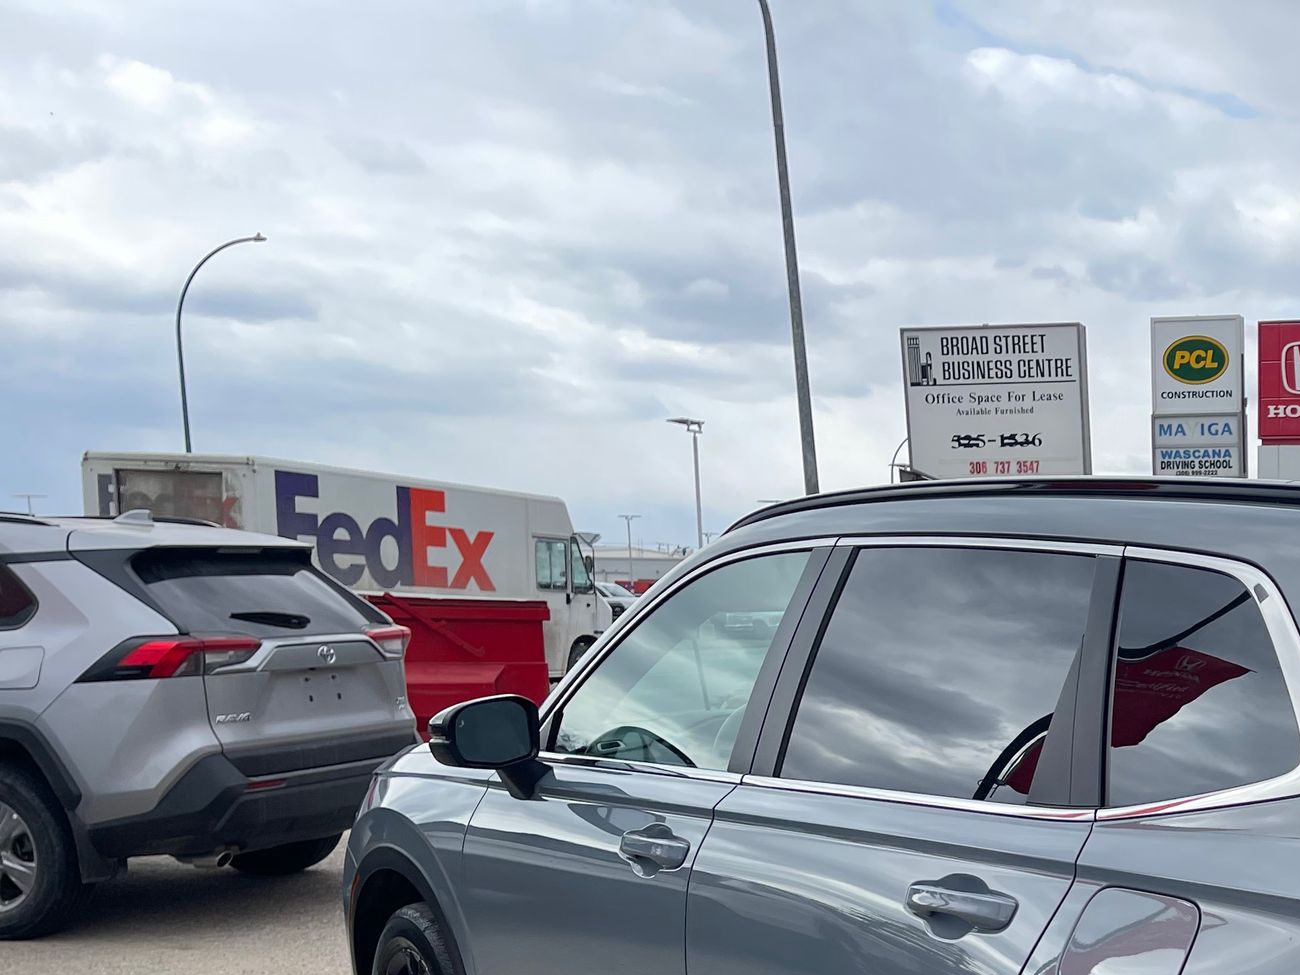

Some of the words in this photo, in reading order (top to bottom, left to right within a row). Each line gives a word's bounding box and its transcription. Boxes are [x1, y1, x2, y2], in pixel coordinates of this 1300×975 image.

[941, 336, 989, 356] BROAD
[993, 334, 1046, 354] STREET
[1173, 350, 1219, 369] PCL
[942, 360, 1013, 381] BUSINESS
[1017, 358, 1073, 379] CENTRE
[925, 392, 964, 405] Office
[968, 392, 1002, 405] Space
[1007, 391, 1026, 402] For
[1032, 390, 1064, 402] Lease
[1160, 390, 1233, 399] CONSTRUCTION
[956, 408, 991, 416] Available
[995, 407, 1034, 415] Furnished
[1160, 449, 1232, 460] WASCANA
[969, 461, 987, 474] 306
[994, 460, 1011, 474] 737
[1017, 460, 1040, 473] 3547
[1160, 460, 1195, 470] DRIVING
[1198, 459, 1233, 469] SCHOOL
[275, 471, 496, 592] FedEx
